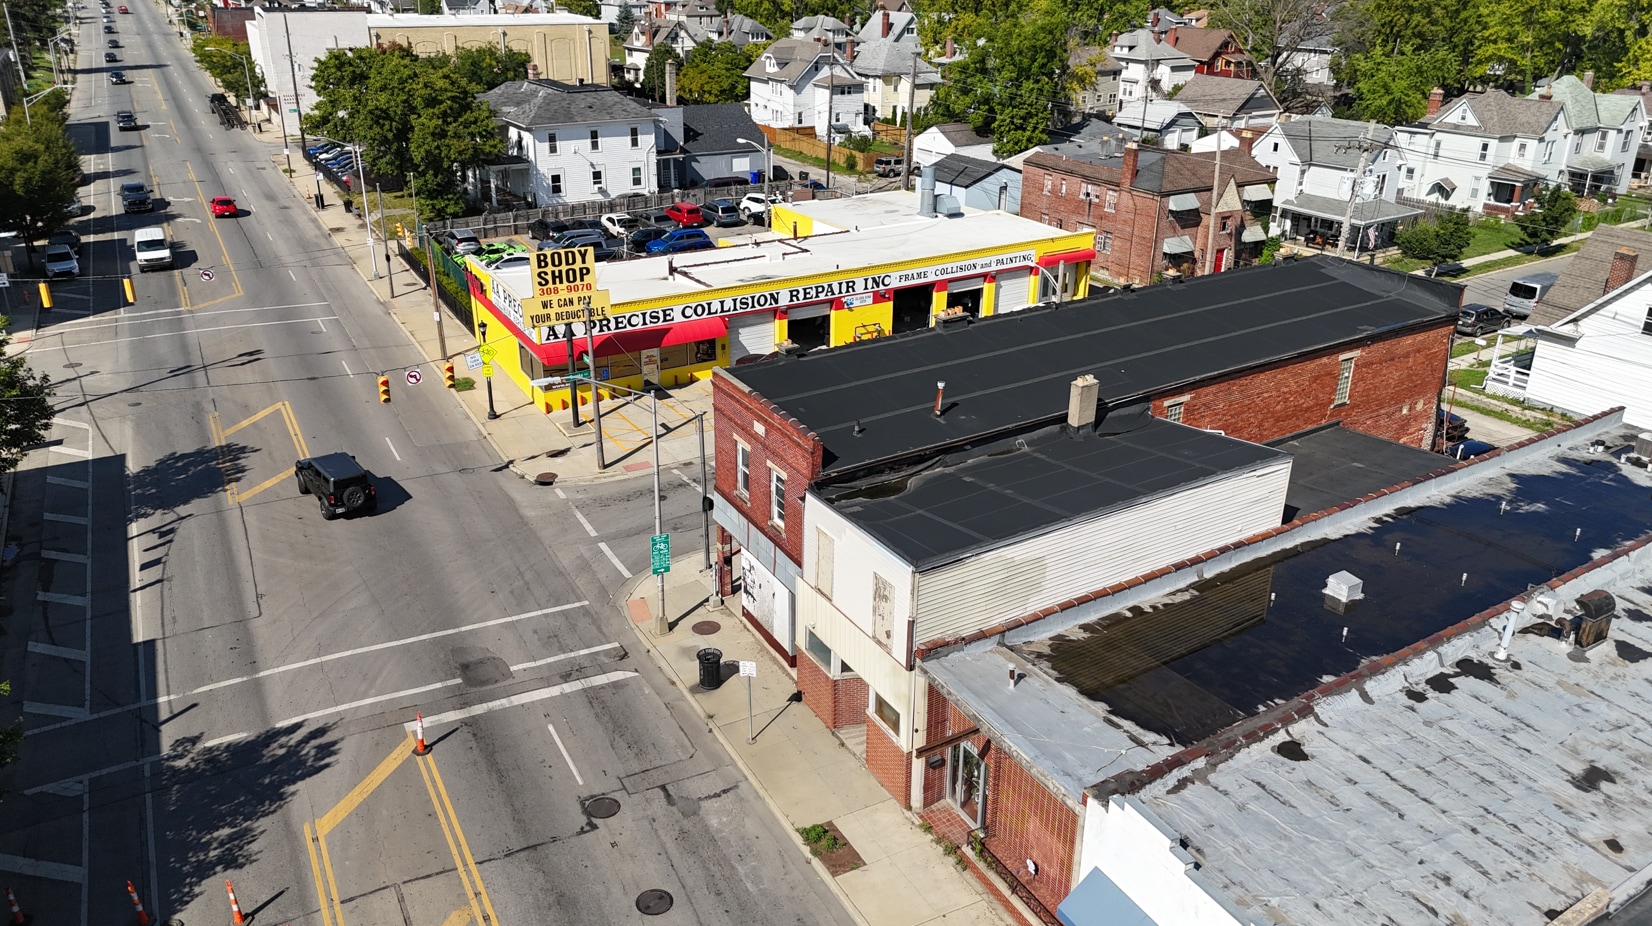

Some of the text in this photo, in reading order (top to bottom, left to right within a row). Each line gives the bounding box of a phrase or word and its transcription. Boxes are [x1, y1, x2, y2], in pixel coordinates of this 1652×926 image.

[536, 248, 589, 269] BODY
[536, 267, 591, 287] SHOP
[538, 283, 592, 296] 308-9070
[584, 308, 674, 335] PRECISE
[681, 291, 780, 319] COLLISION
[789, 280, 856, 302] REPAIR
[863, 274, 892, 290] INC
[898, 270, 928, 283] FRAME
[934, 262, 978, 277] COLLISION
[980, 260, 992, 269] and
[995, 253, 1032, 266] PAINTING
[541, 295, 592, 310] WE CAN PAY
[530, 312, 551, 324] YOUR
[555, 307, 606, 321] DEDUCTBLE
